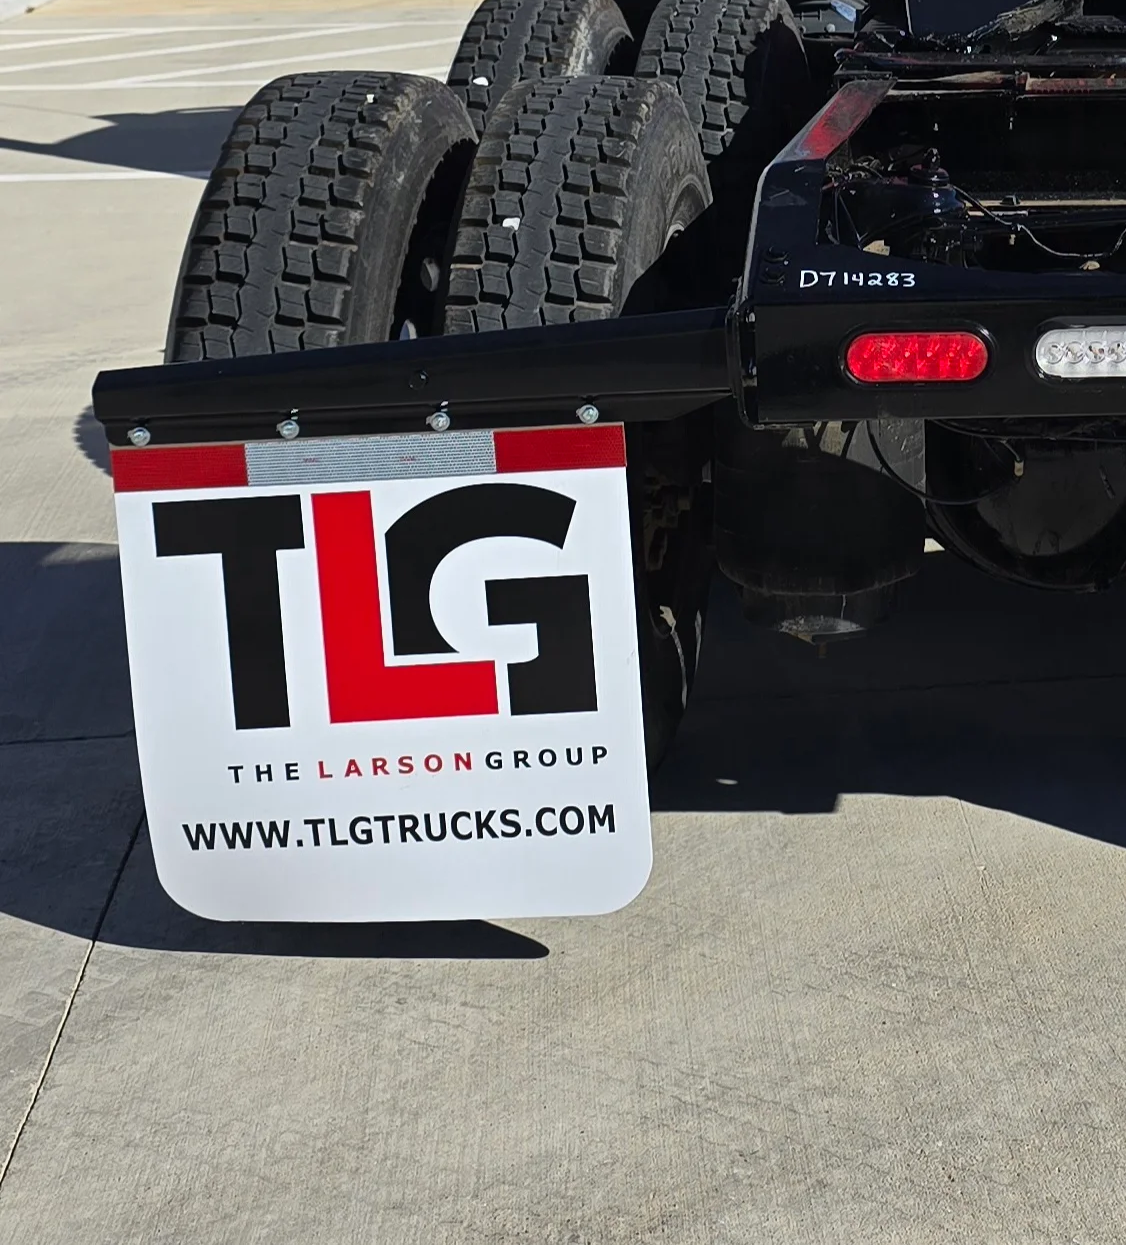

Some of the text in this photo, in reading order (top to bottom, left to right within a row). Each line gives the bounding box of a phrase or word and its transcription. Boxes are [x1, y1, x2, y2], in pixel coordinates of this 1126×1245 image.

[799, 269, 916, 288] D714283
[151, 483, 598, 731] TLG
[228, 745, 609, 784] THE LARSON GROUP
[182, 804, 616, 851] WWW.TLGTRUCKS.COM
